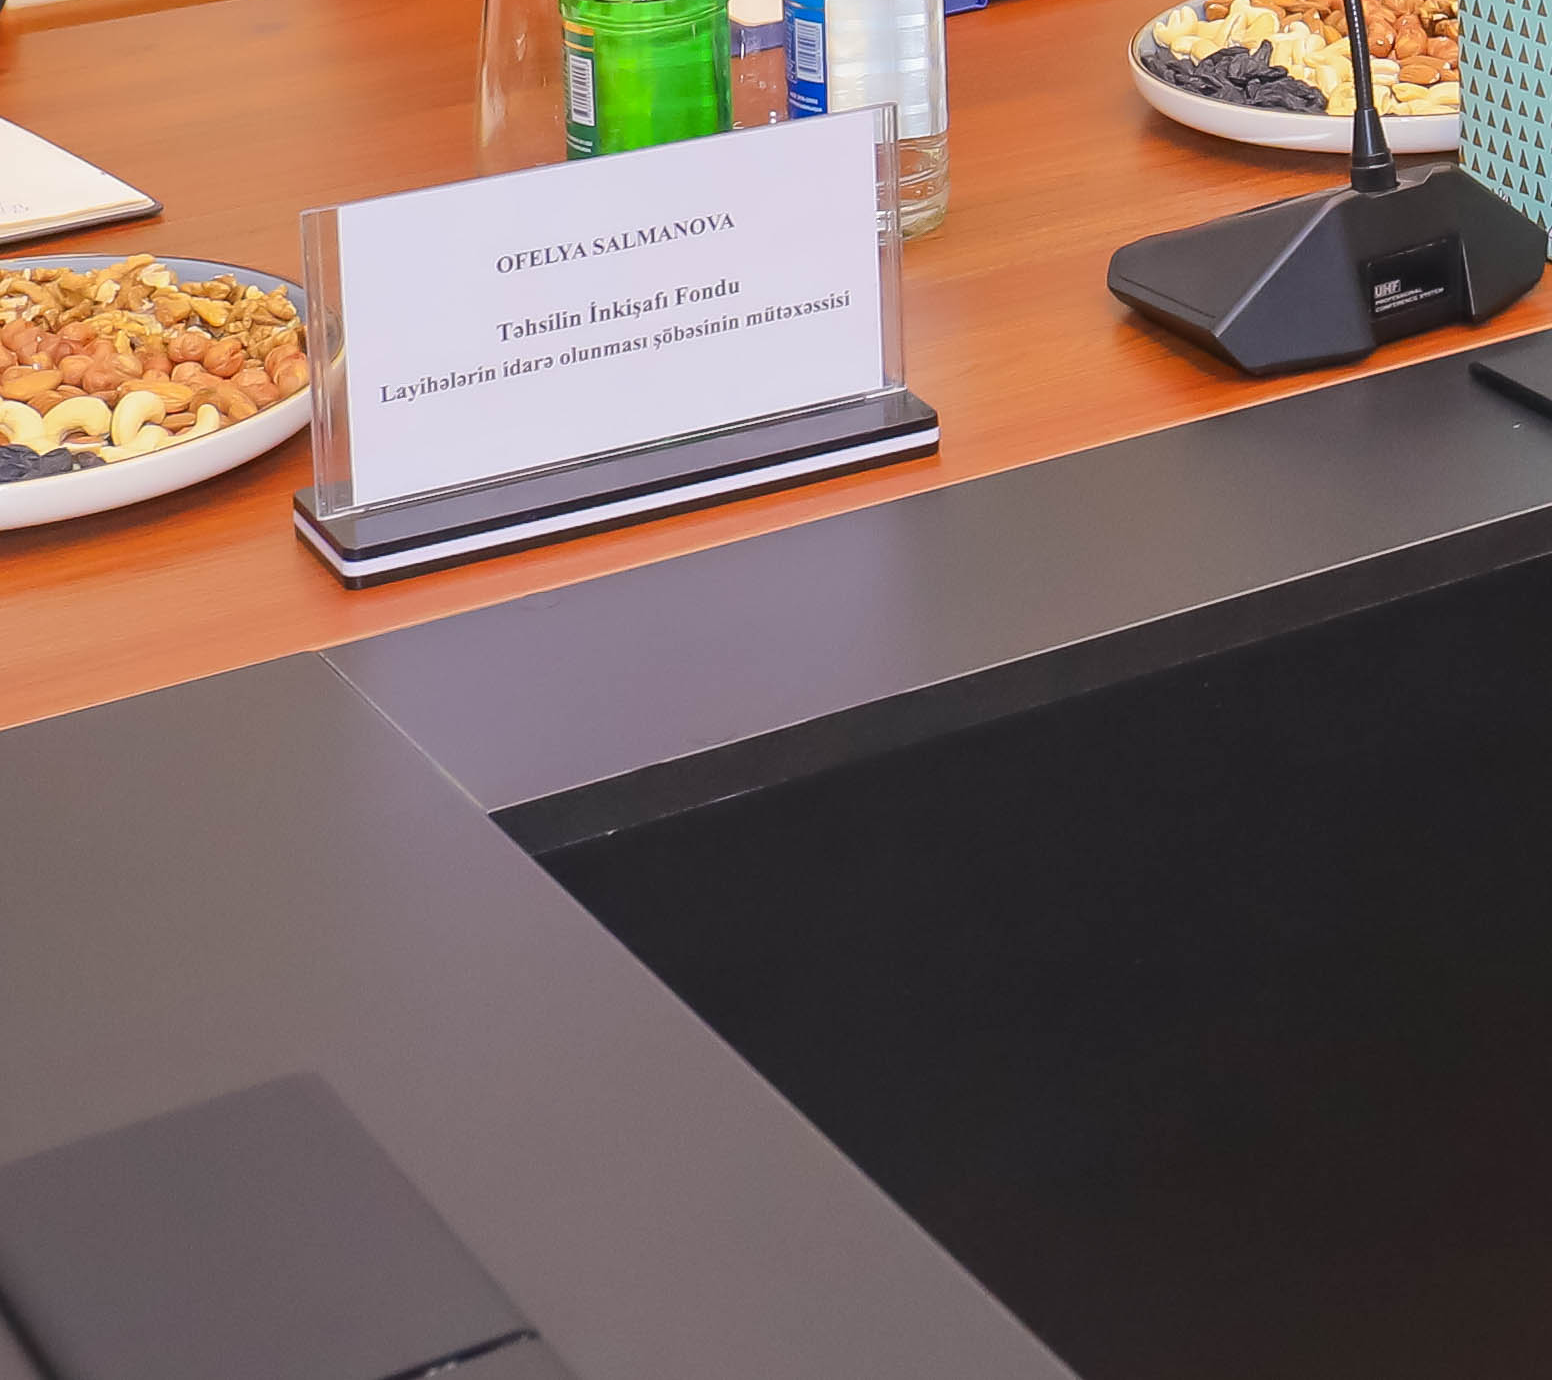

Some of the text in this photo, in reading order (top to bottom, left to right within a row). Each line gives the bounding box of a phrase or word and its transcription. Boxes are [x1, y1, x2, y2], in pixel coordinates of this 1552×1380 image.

[496, 213, 735, 274] OFELYA SALMANOVA
[496, 278, 740, 342] Təhsilin İnkişafı Fondu
[380, 290, 850, 403] Layihələrin idarə olunması şöbəsinin mütəxəssisi
